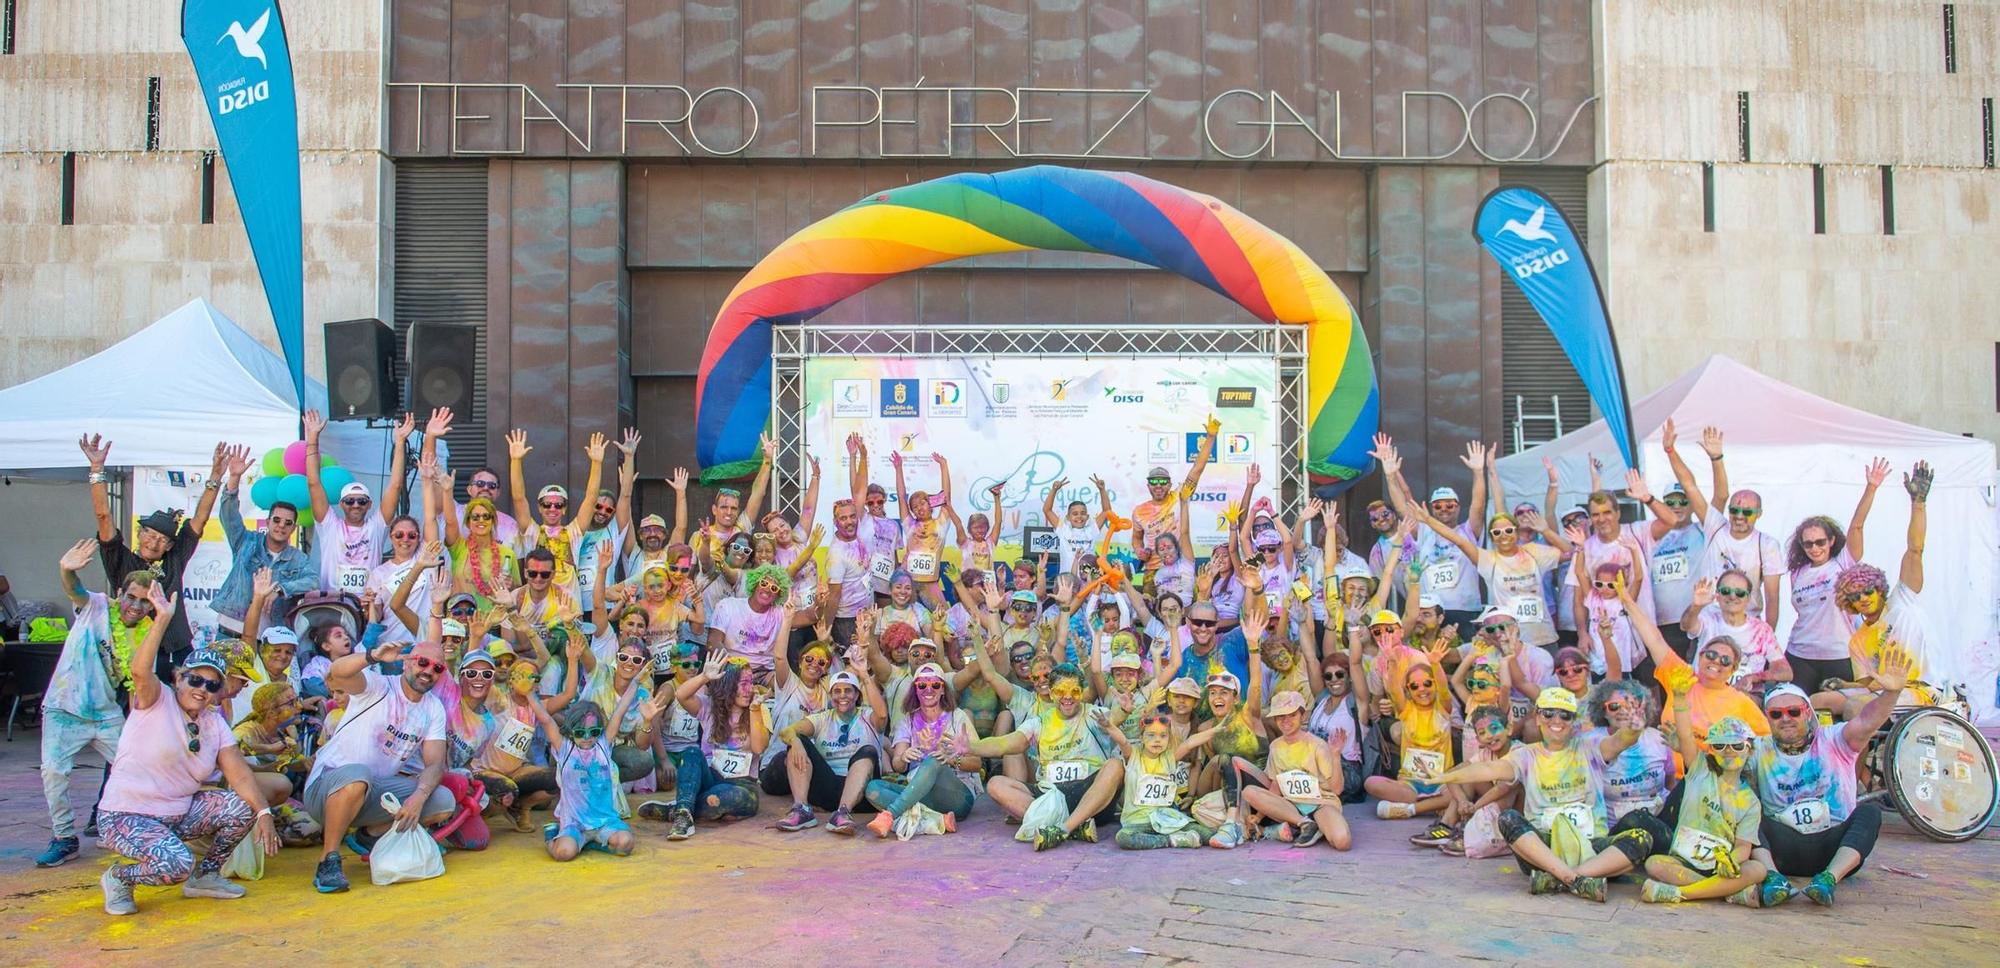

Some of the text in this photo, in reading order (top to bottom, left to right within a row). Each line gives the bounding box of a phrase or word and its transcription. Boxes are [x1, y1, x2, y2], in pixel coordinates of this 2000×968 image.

[387, 76, 1599, 161] TEATRO PÉREZ GALDÓS
[875, 562, 890, 575] 375
[912, 558, 931, 570] 366
[1660, 562, 1681, 575] 492
[343, 573, 365, 587] 393
[1434, 571, 1453, 584] 253
[1517, 604, 1537, 616] 489
[722, 760, 737, 775] 22
[1056, 766, 1079, 783] 341
[1145, 784, 1168, 799] 294
[1286, 779, 1311, 795] 298
[1792, 807, 1813, 826] 18
